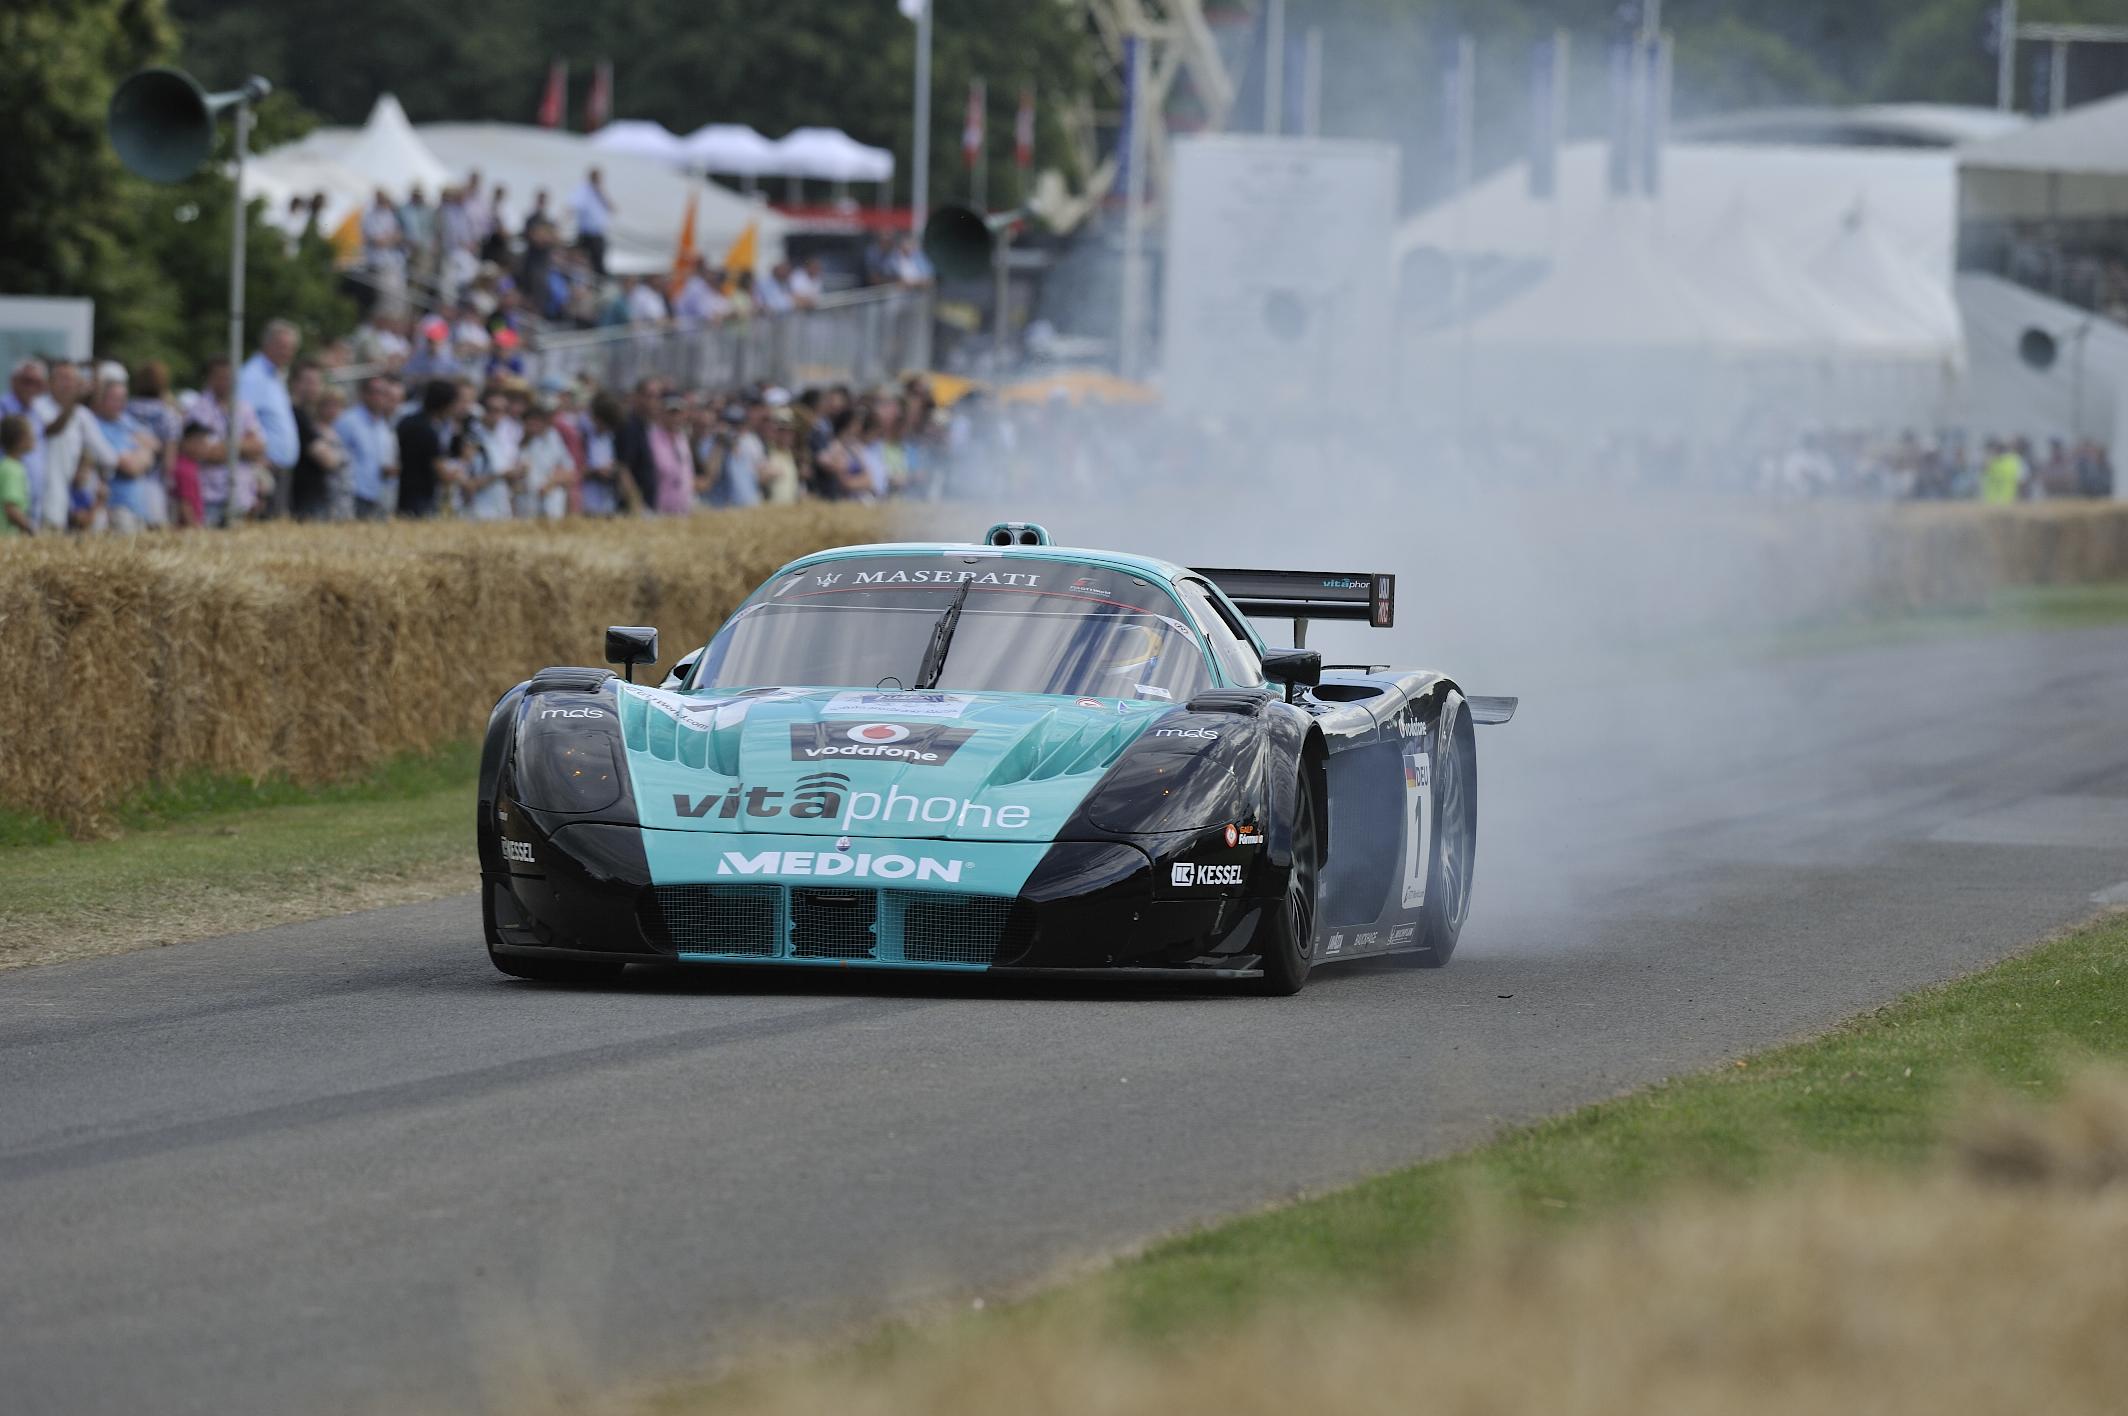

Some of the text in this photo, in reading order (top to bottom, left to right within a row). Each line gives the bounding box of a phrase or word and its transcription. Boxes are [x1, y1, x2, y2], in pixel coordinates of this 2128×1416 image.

[772, 576, 806, 598] 1
[853, 570, 1041, 587] MASERATI
[541, 707, 604, 720] mds
[1155, 727, 1219, 741] mds
[805, 744, 939, 761] vodafone
[672, 771, 1031, 831] vitaphone
[1415, 795, 1422, 879] 1
[1196, 865, 1244, 885] KESSEL
